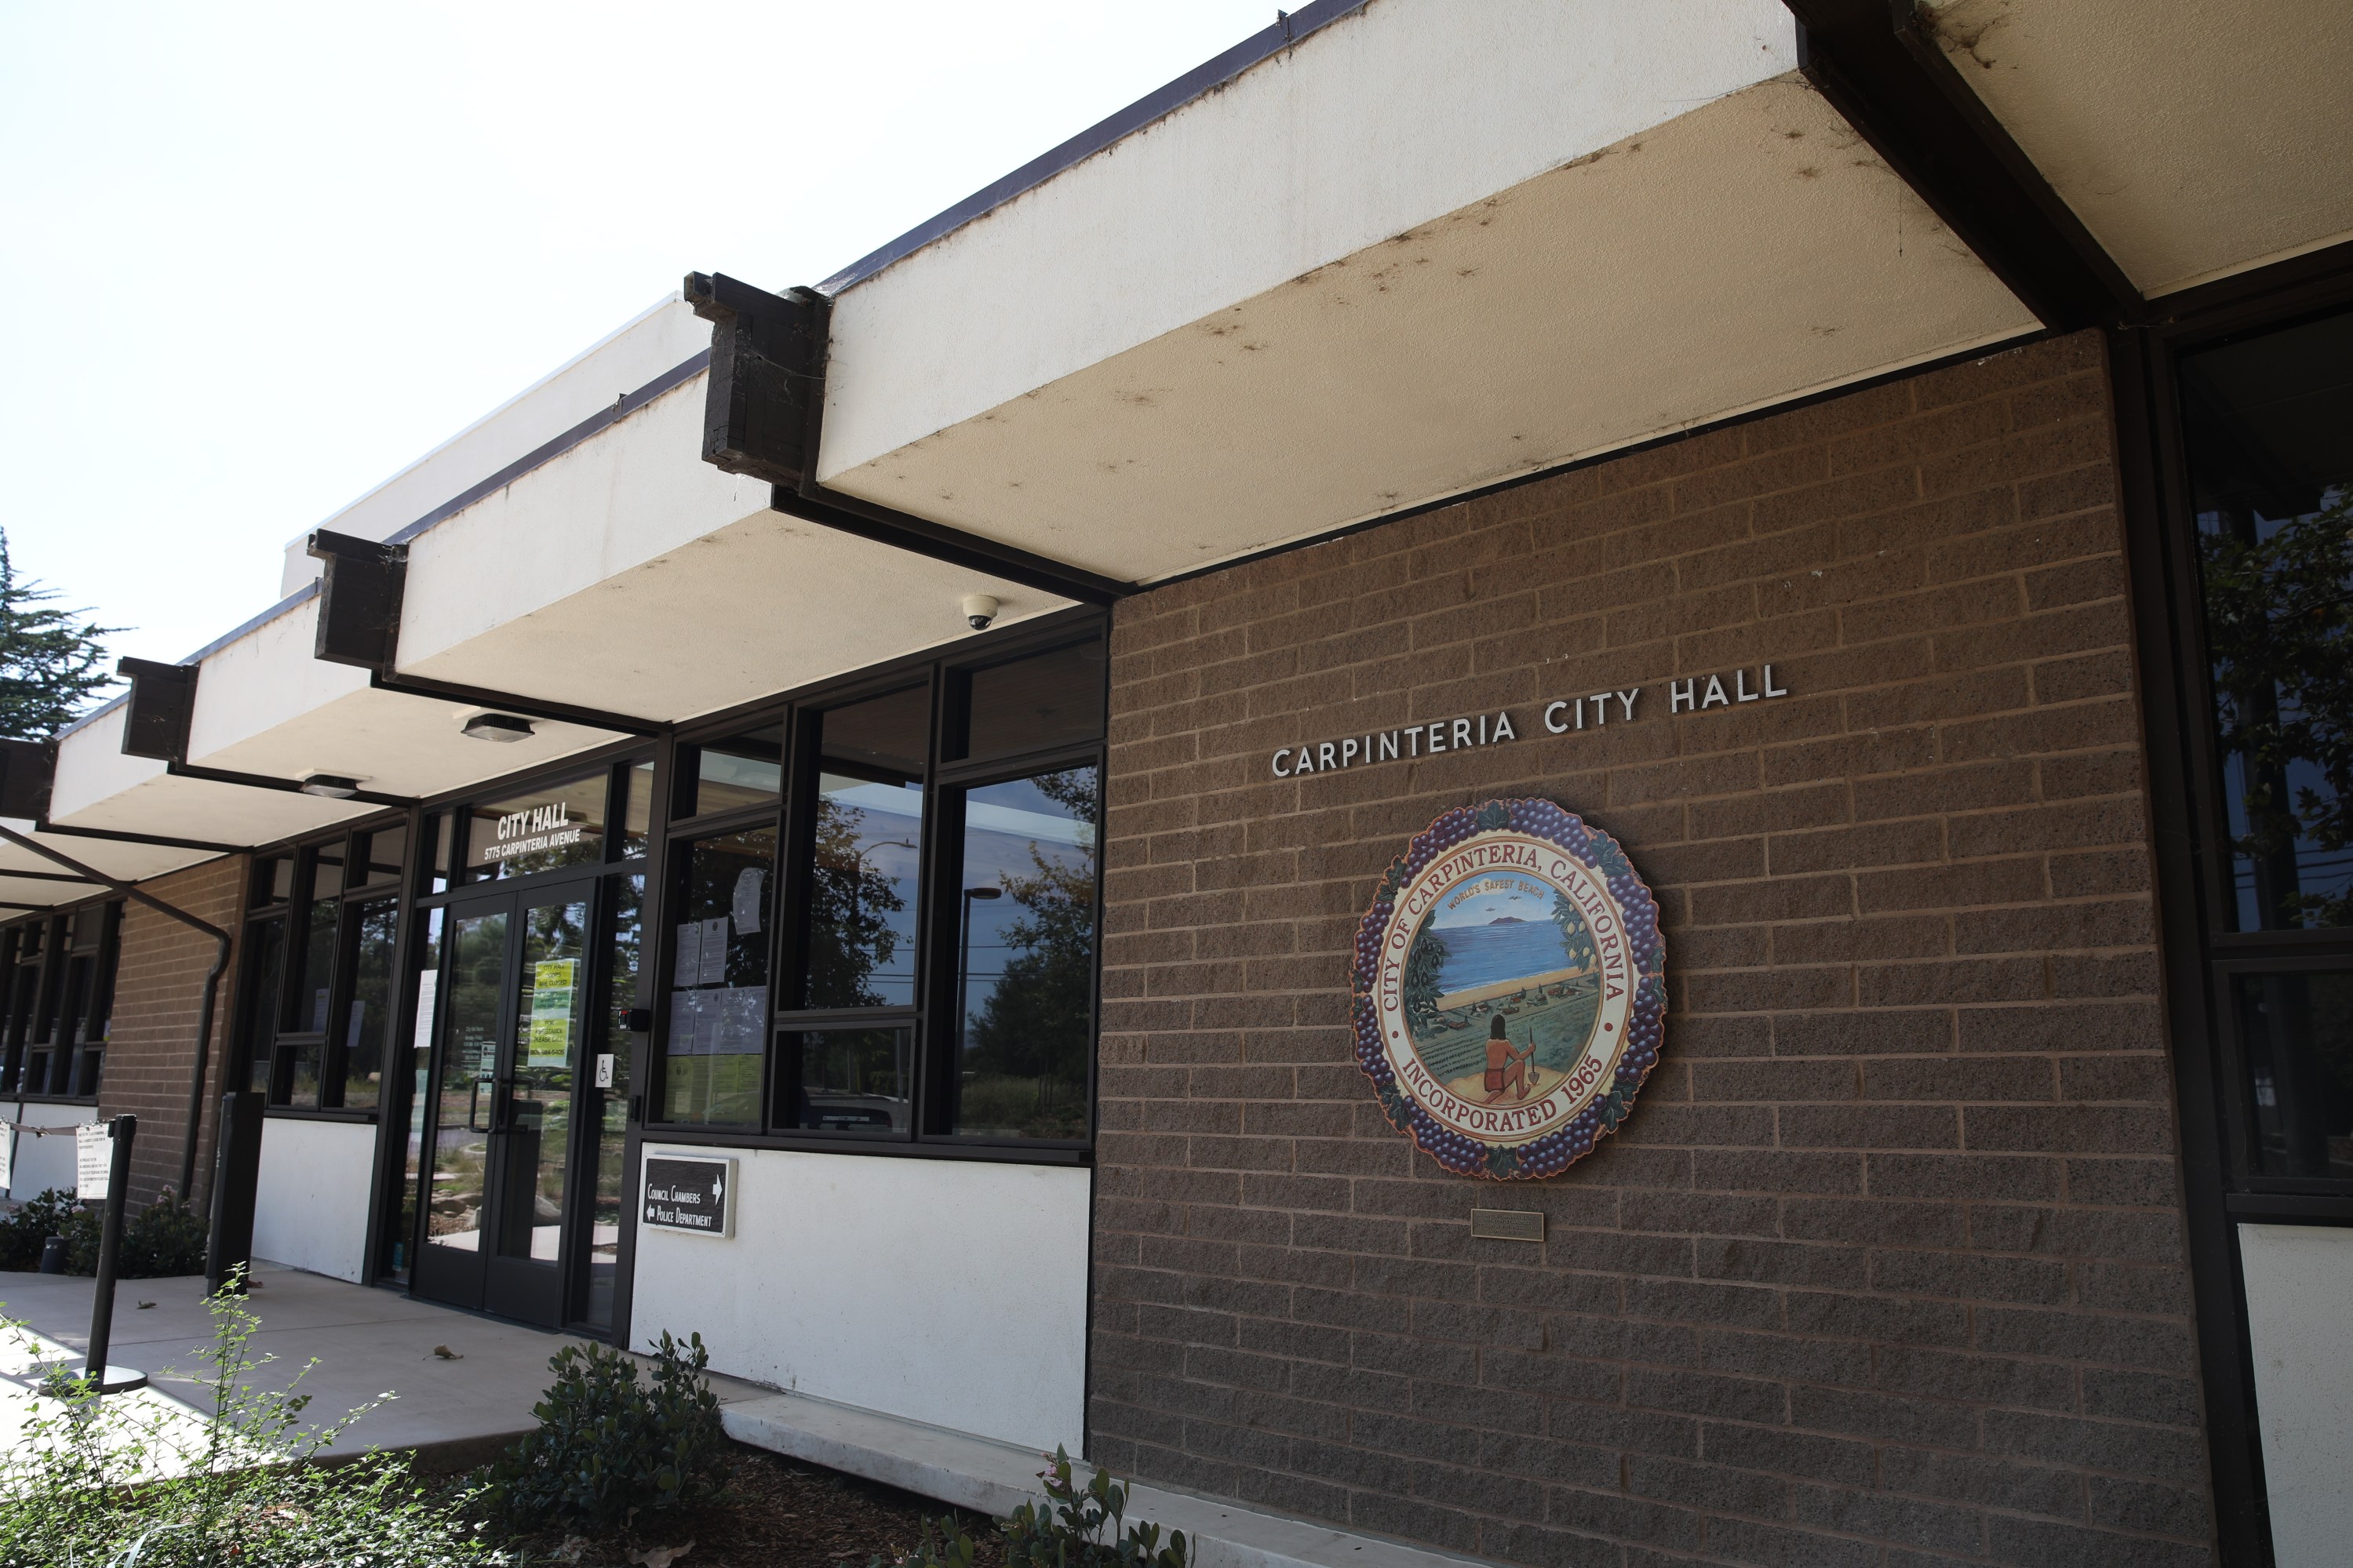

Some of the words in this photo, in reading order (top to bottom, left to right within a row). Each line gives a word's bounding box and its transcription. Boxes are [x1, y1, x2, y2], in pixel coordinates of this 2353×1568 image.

[1272, 711, 1516, 777] CARPINTERIA
[1544, 688, 1640, 734] CITY
[1671, 664, 1787, 714] HALL
[484, 846, 501, 860] 5775
[501, 835, 548, 857] CARPINTERIA
[548, 828, 581, 848] AVENUE
[497, 809, 530, 841] CITY
[531, 802, 569, 833] HALL
[1408, 844, 1542, 915] CARPINTERIA,
[1447, 884, 1481, 910] WORLD'S
[1484, 879, 1515, 892] SAFEST
[1517, 881, 1546, 900] BEACH
[1391, 919, 1410, 950] OF
[1550, 860, 1625, 1001] CALIFORNIA
[1384, 958, 1401, 1012] CITY
[1402, 1058, 1557, 1133] INCORPORATED
[1561, 1054, 1603, 1104] 1965
